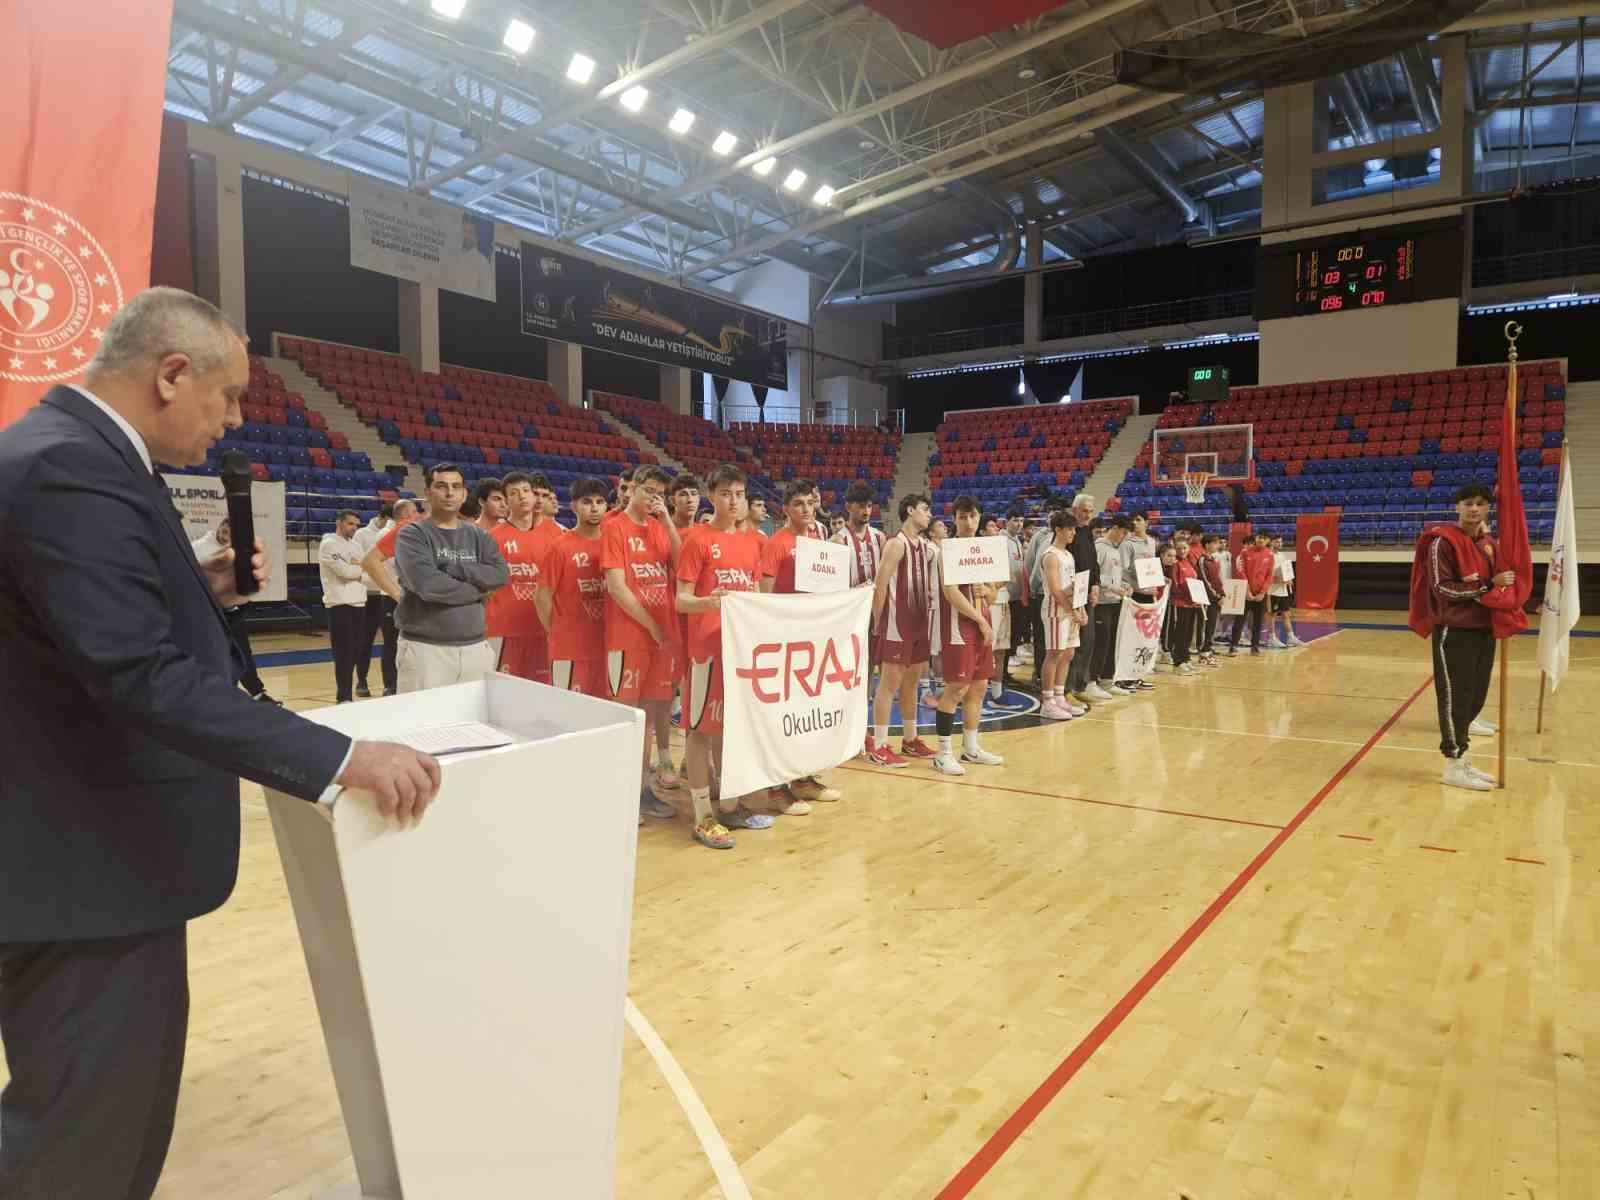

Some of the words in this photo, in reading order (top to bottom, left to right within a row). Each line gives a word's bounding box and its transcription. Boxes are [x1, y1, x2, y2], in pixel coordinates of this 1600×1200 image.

[62, 254, 78, 273] VE
[73, 271, 89, 304] SPOR
[1324, 271, 1340, 285] 03
[1366, 265, 1382, 279] 01
[1348, 281, 1356, 293] 4
[619, 329, 665, 349] ADAMLAR
[503, 540, 519, 554] 11
[627, 536, 646, 552] 12
[711, 543, 722, 559] 5
[970, 546, 981, 554] 06
[572, 552, 591, 567] 12
[819, 552, 829, 561] 01
[959, 557, 994, 567] ANKARA
[811, 563, 837, 575] ADANA
[623, 669, 641, 689] 21
[782, 706, 844, 737] Okulları
